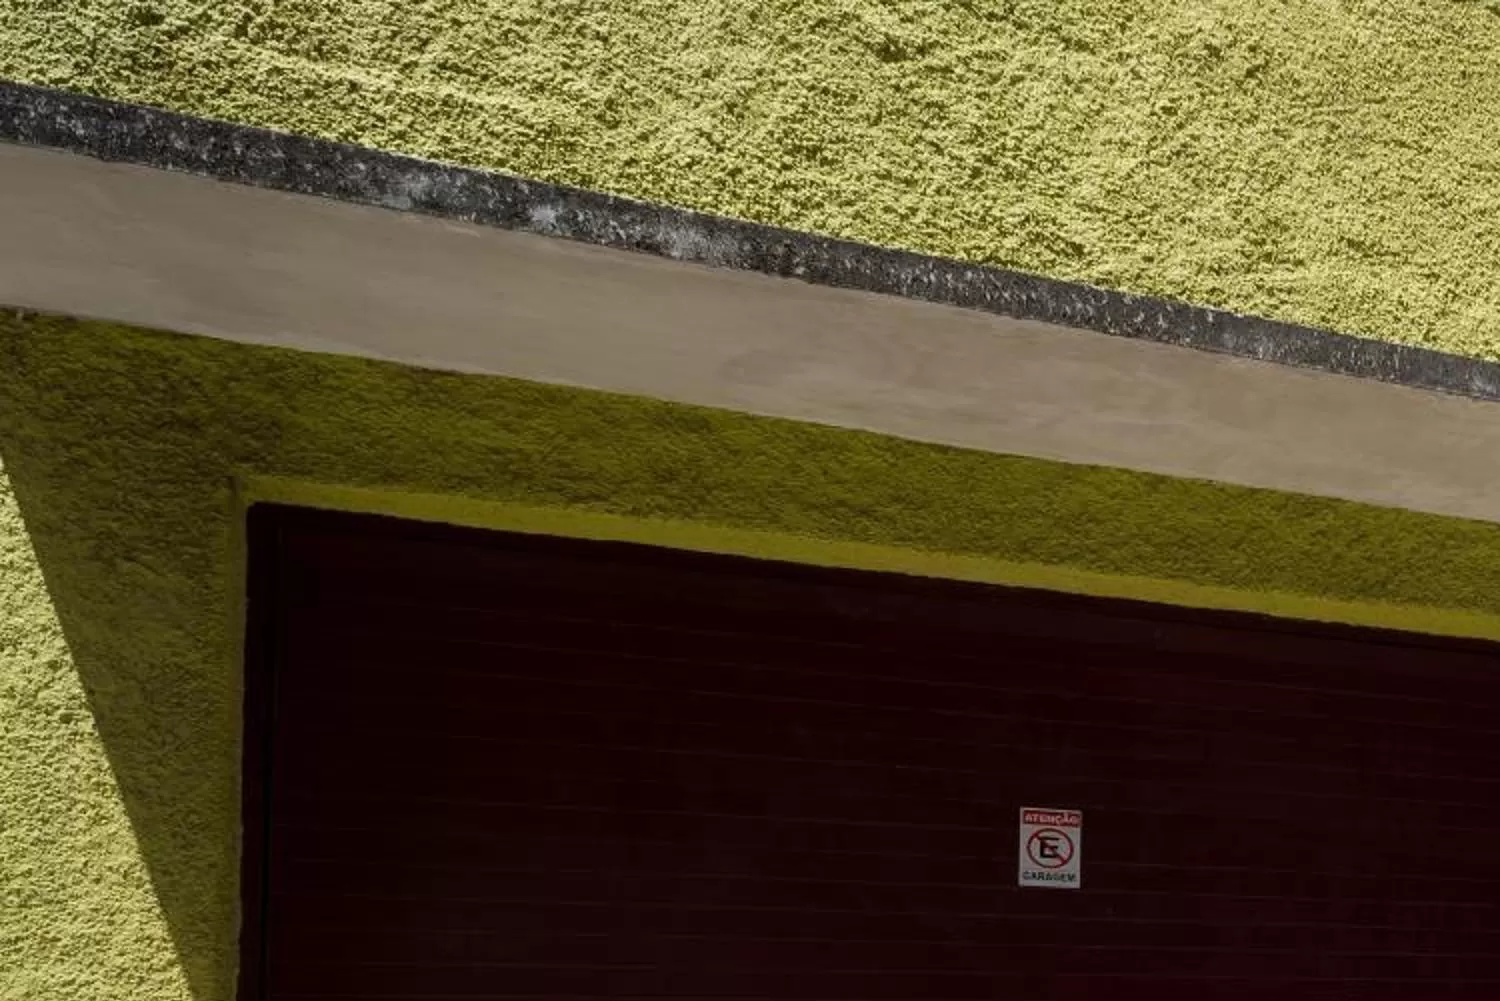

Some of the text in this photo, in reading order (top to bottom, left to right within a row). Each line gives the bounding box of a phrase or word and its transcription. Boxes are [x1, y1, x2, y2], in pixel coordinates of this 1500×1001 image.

[1024, 812, 1079, 826] ATENÇÃO
[1040, 836, 1060, 858] E
[1023, 871, 1076, 882] GARAGEM
